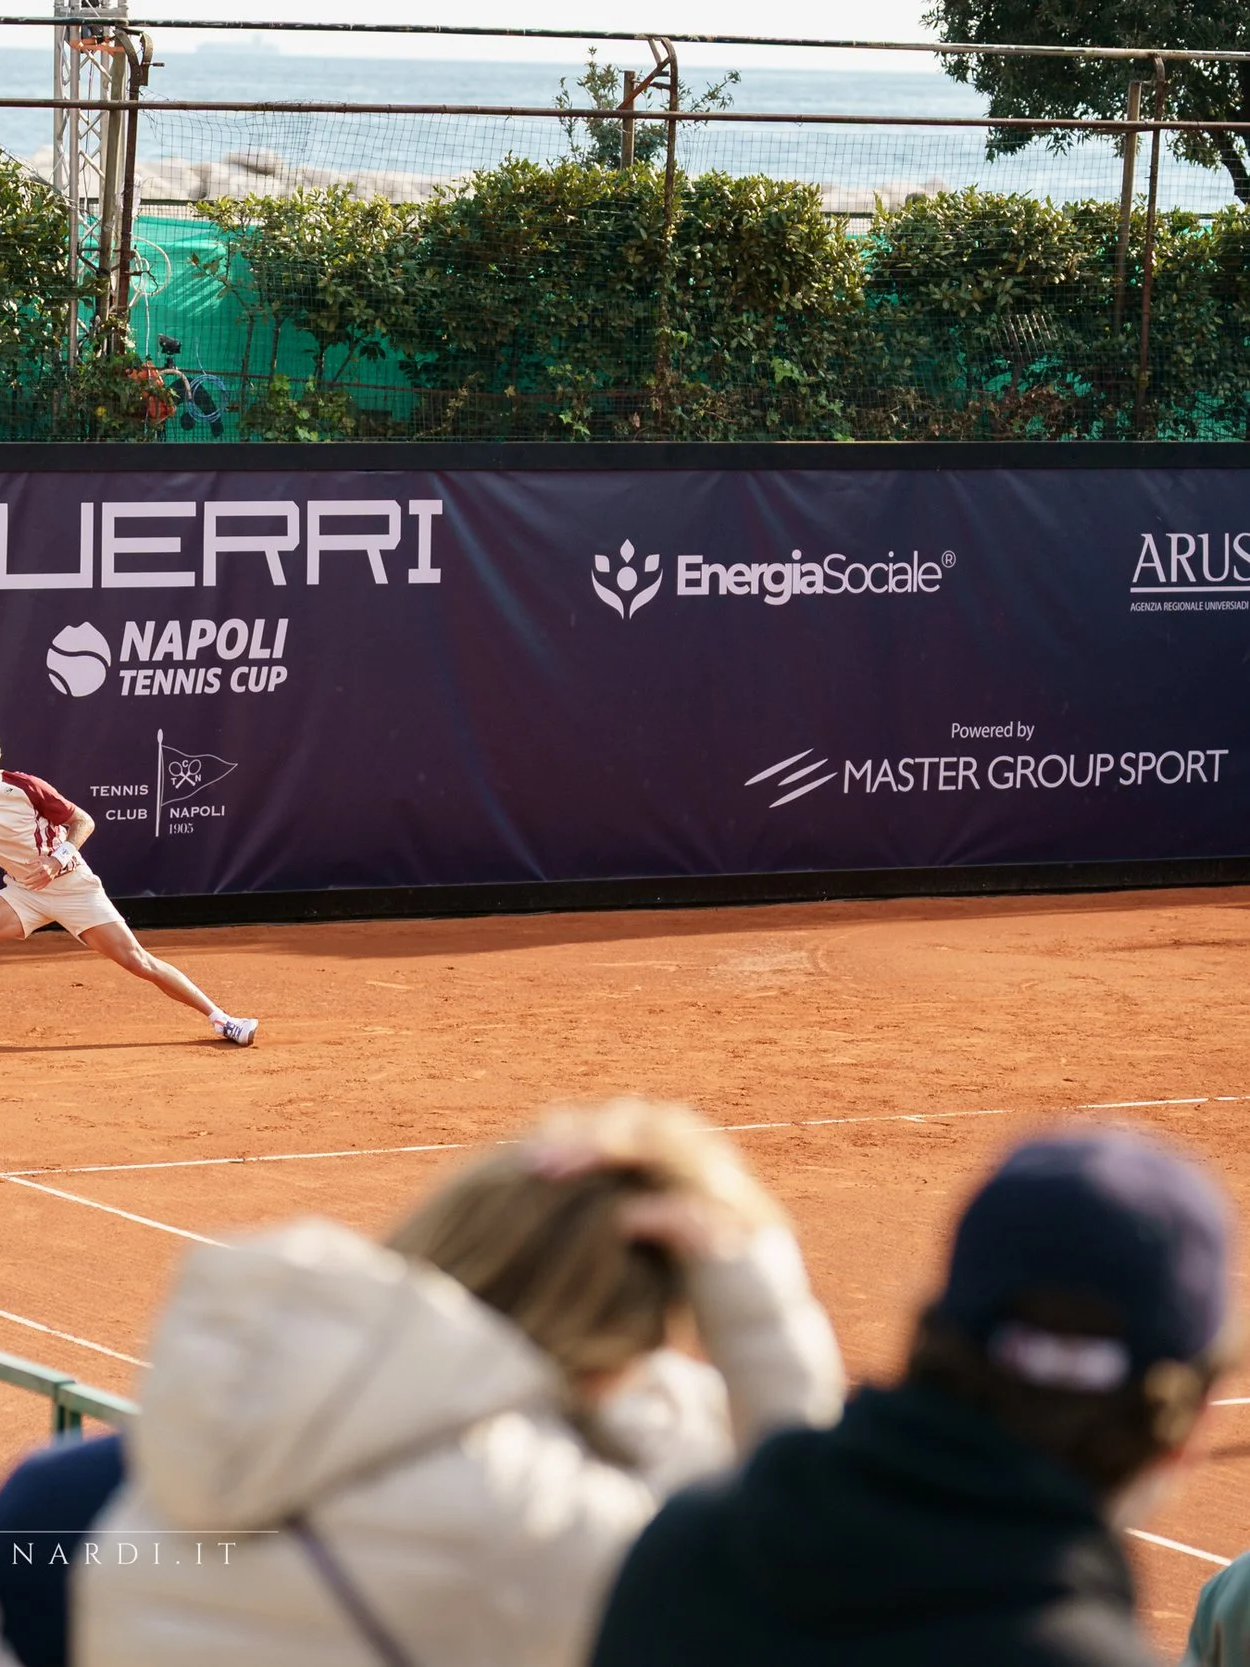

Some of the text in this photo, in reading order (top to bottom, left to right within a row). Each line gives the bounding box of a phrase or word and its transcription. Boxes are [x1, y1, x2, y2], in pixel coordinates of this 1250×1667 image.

[1132, 532, 1250, 583] ARUS
[1130, 600, 1249, 612] AGENZIA REGIONALE UNIVERSIADI
[119, 618, 289, 662] NAPOLI
[119, 665, 288, 697] TENNIS CUP
[951, 720, 1035, 742] Powered by
[843, 749, 1229, 794] MASTER GROUP SPORT
[90, 784, 149, 797] TENNIS
[105, 805, 225, 820] CLUB NAPOLI
[169, 823, 194, 835] 1905
